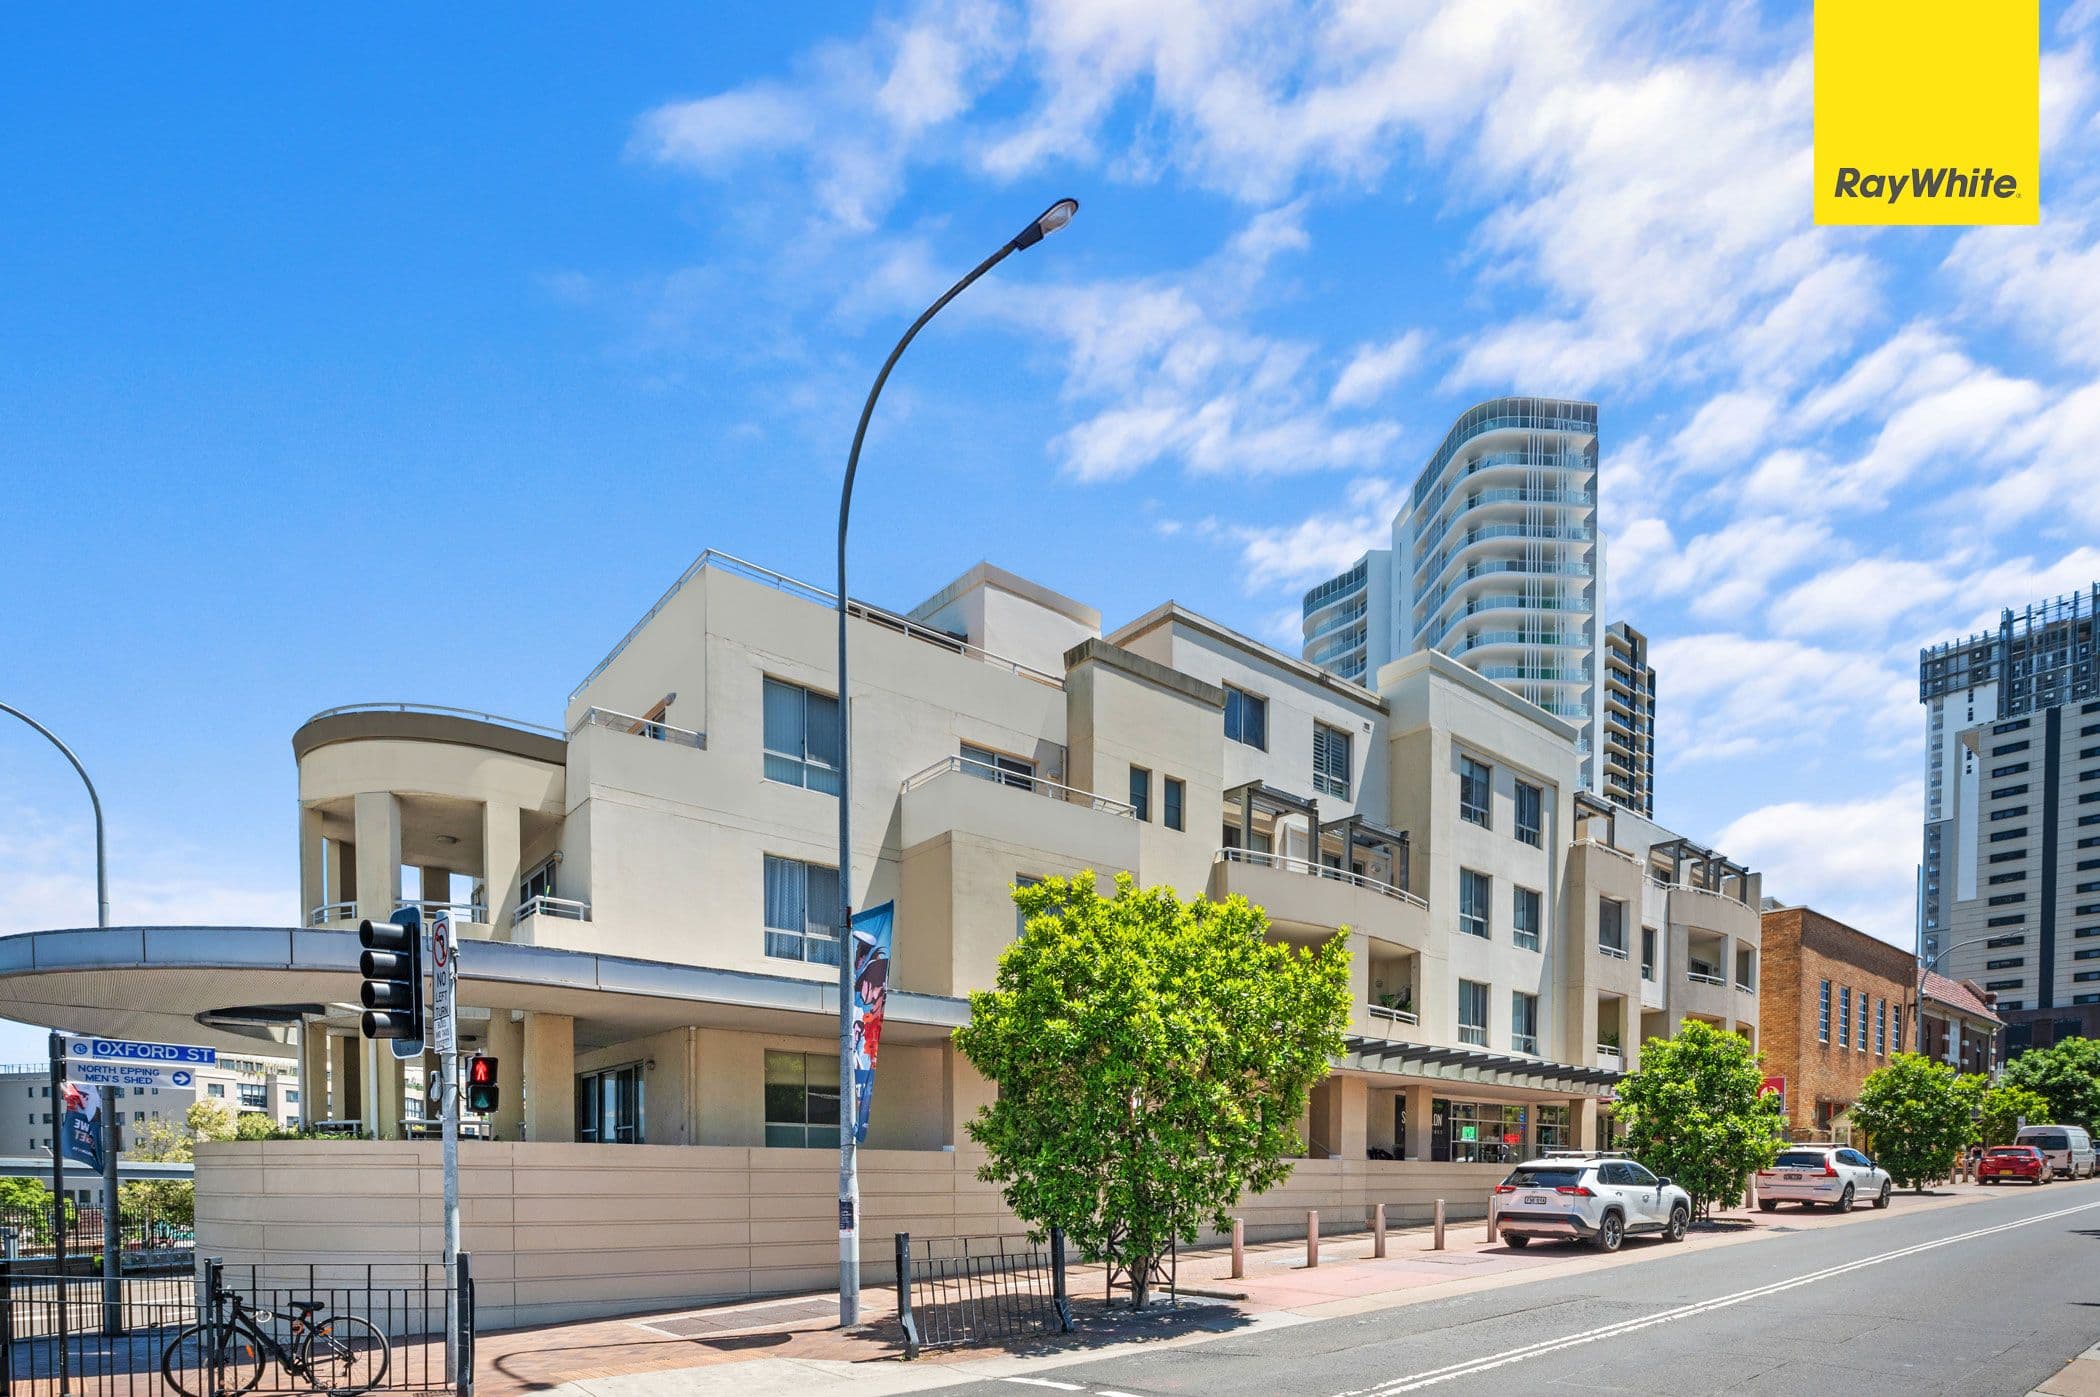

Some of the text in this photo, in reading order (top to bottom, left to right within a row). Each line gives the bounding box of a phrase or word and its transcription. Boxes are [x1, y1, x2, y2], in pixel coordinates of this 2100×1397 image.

[437, 971, 446, 988] NO
[436, 990, 447, 1003] LEFT
[436, 1006, 448, 1018] TURN
[97, 1042, 212, 1062] OXFORD ST
[78, 1064, 160, 1077] NORTH EPPING
[85, 1074, 153, 1085] MEN'S SHED
